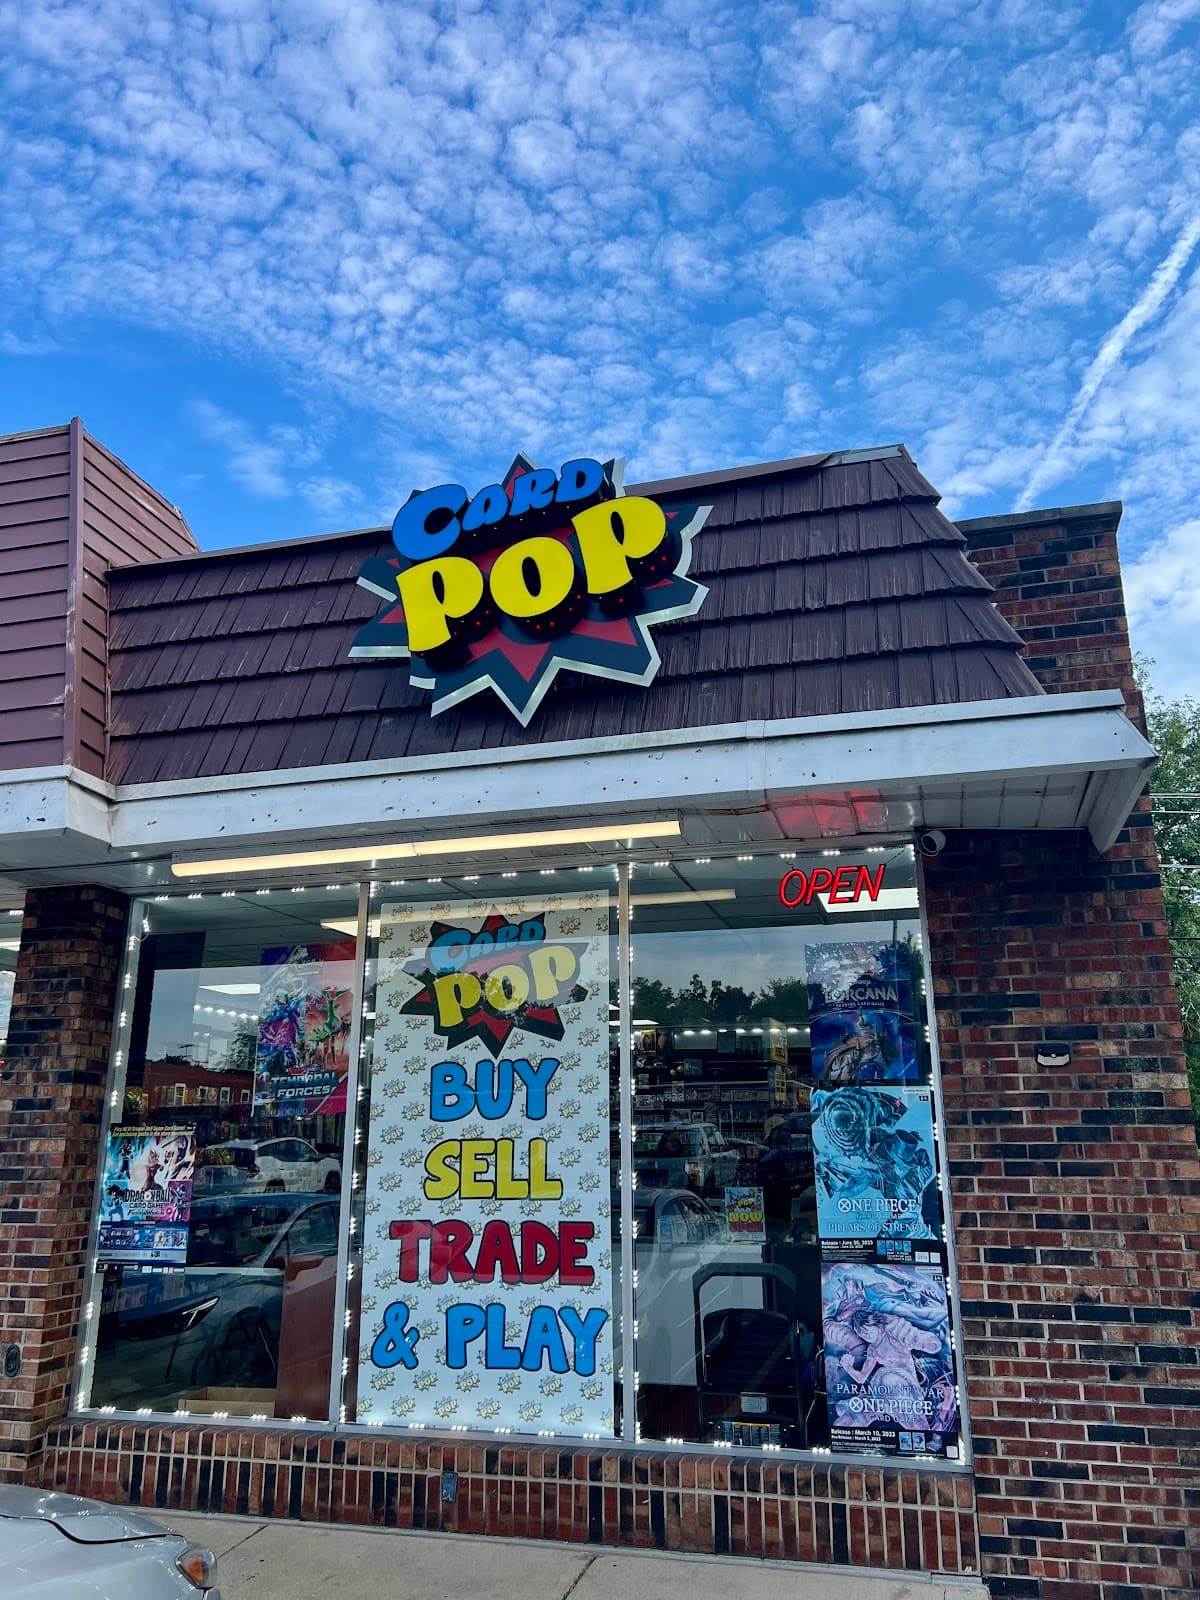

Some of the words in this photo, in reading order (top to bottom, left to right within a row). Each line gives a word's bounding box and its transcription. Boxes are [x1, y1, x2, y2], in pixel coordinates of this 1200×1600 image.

[396, 496, 667, 652] POP
[778, 863, 886, 908] OPEN
[433, 945, 576, 1027] POP
[277, 1084, 334, 1098] FORCES
[430, 1057, 561, 1122] BUY
[423, 1137, 564, 1200] SELL
[728, 1212, 763, 1223] NOW
[837, 1198, 872, 1213] ONE
[876, 1198, 917, 1213] PIECE
[828, 1222, 864, 1233] PILLARS
[882, 1222, 933, 1234] STRENGTH
[388, 1218, 595, 1286] TRADE
[371, 1301, 421, 1370] &
[446, 1302, 610, 1377] PLAY
[836, 1383, 912, 1396] PARAMOUNT
[848, 1396, 886, 1413] ONE
[889, 1399, 934, 1416] PIECE
[855, 1429, 872, 1437] March
